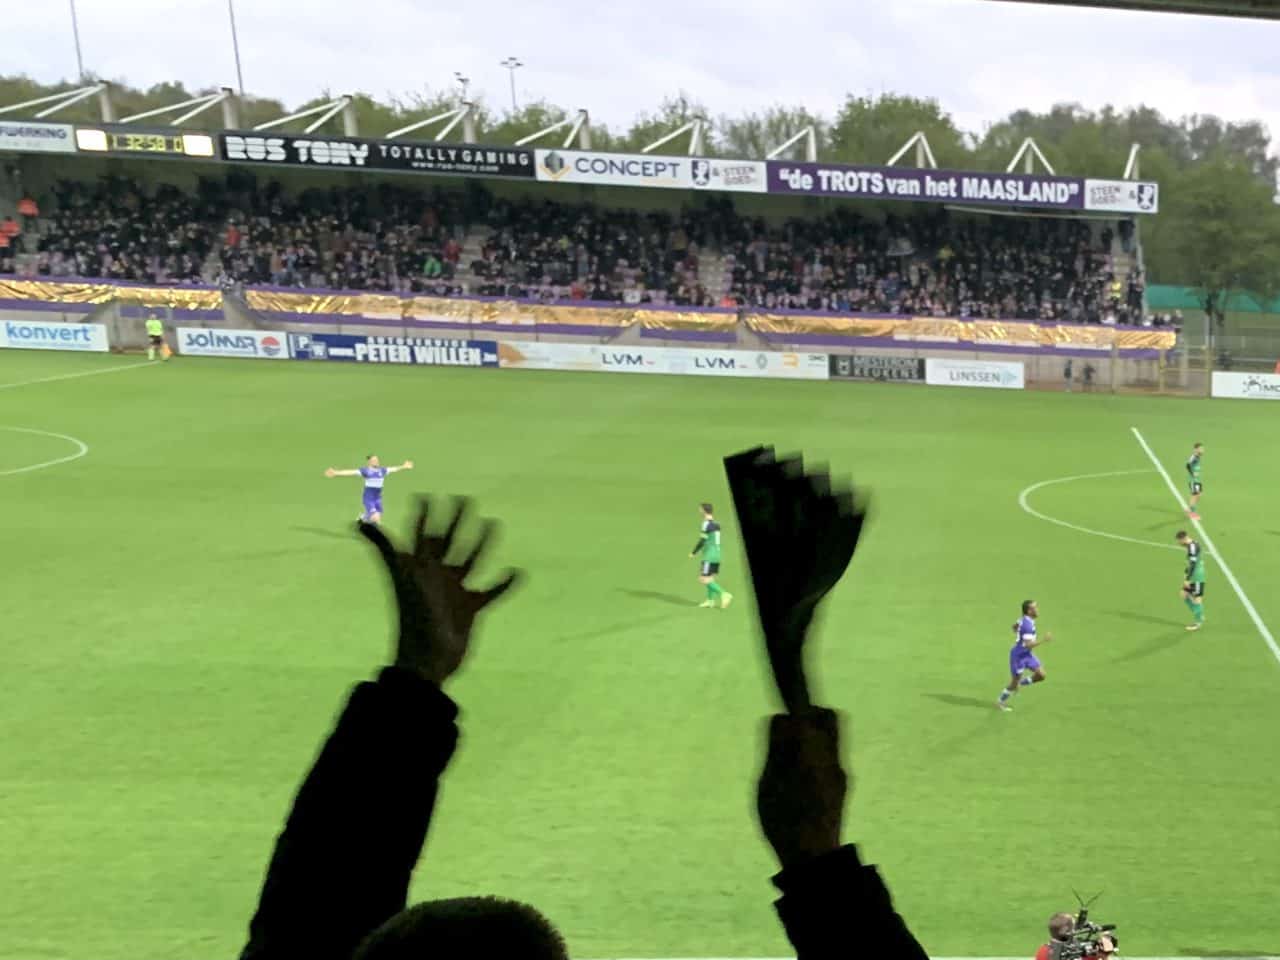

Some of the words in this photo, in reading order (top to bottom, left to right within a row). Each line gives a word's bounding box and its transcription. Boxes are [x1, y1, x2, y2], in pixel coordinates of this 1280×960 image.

[225, 136, 287, 161] RUS
[379, 145, 457, 162] TOTALLY
[462, 150, 529, 165] GAMING
[575, 157, 680, 178] CONCEPT
[817, 170, 884, 194] TROTS
[885, 178, 921, 195] van
[925, 176, 957, 198] het
[5, 322, 91, 342] konvert
[355, 343, 411, 362] PETER
[602, 353, 642, 366] LVM
[695, 357, 735, 369] LVM
[949, 370, 1000, 383] LINSSEN
